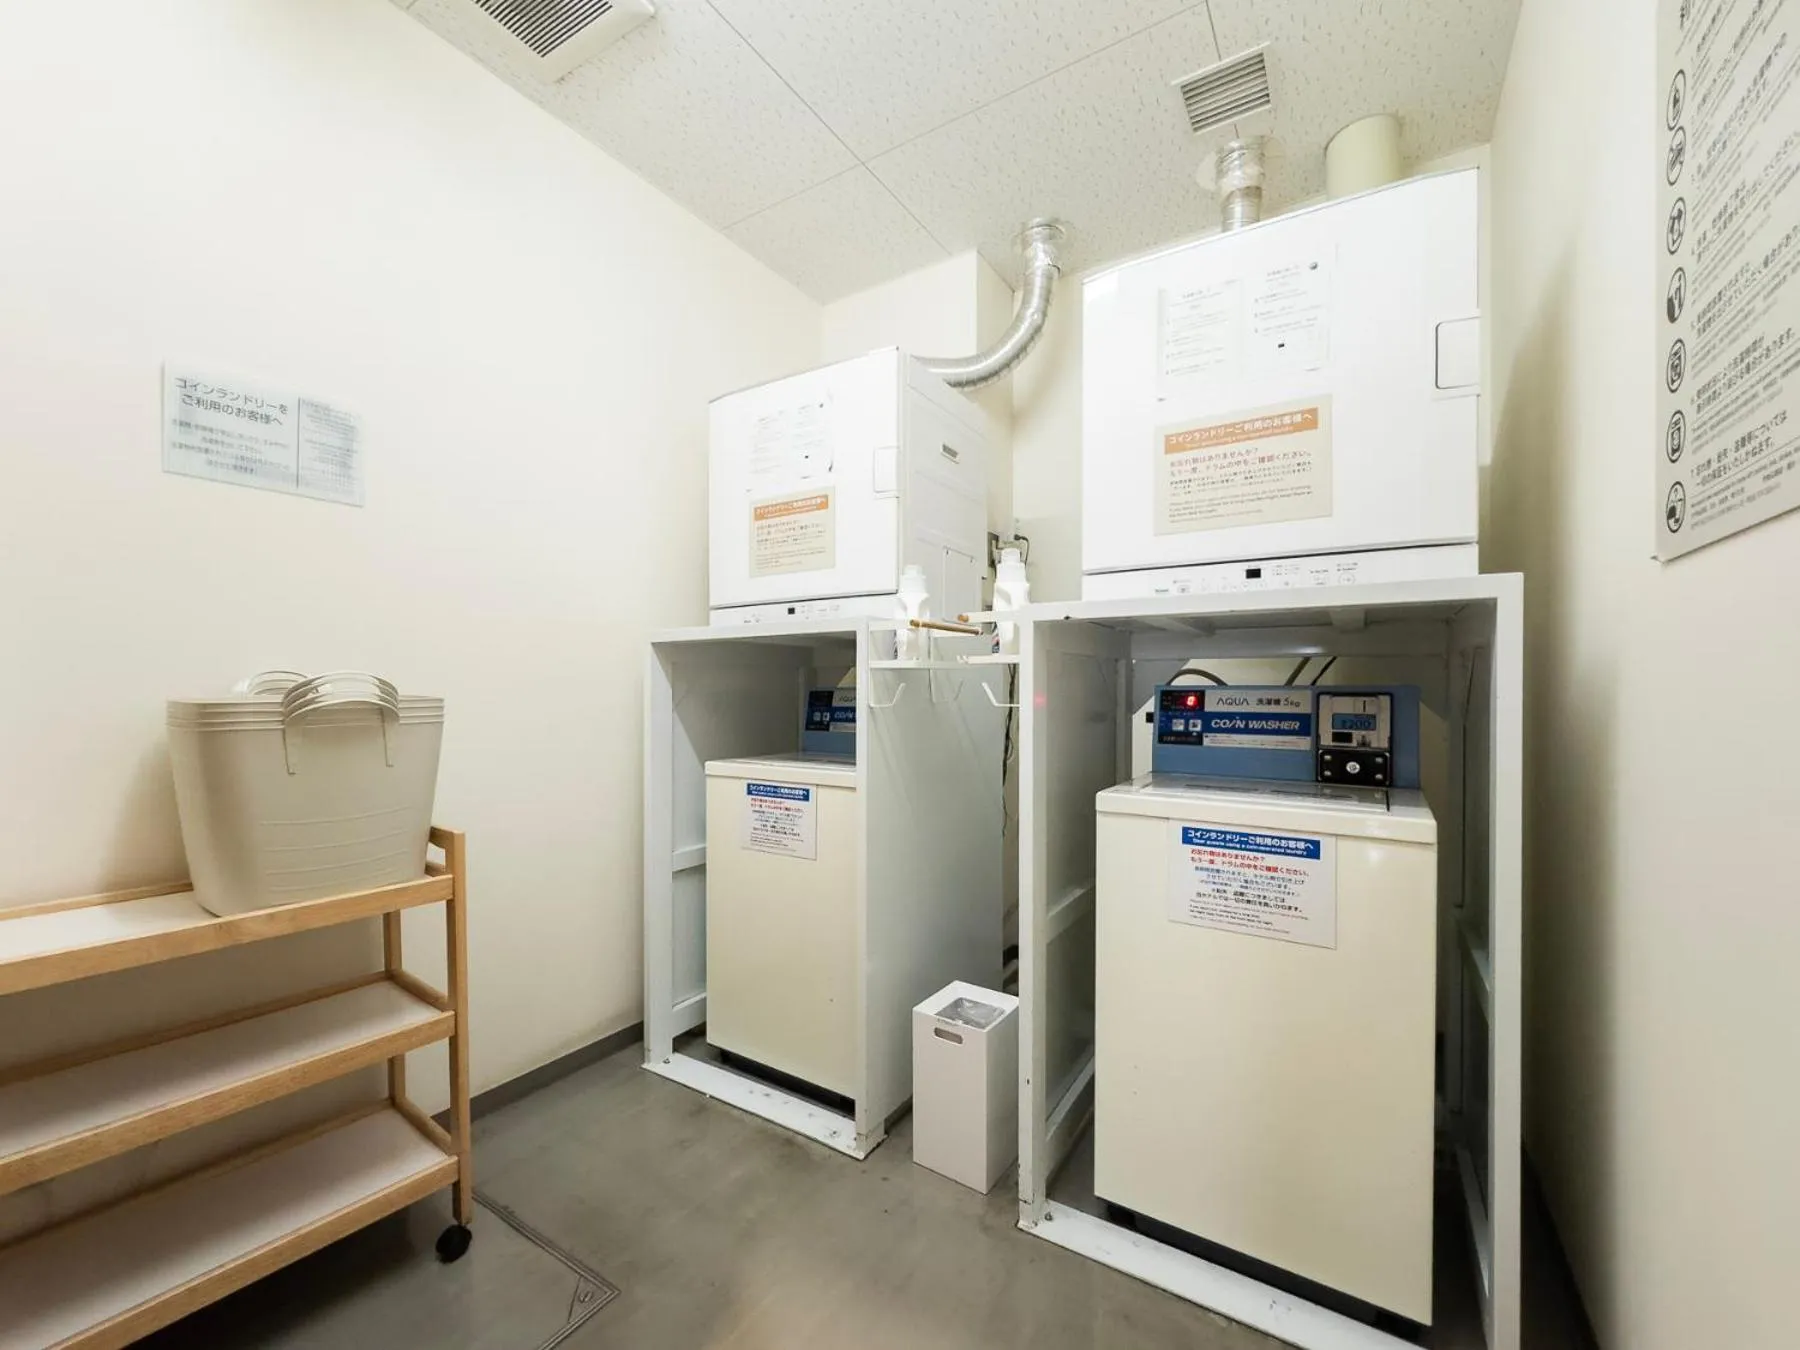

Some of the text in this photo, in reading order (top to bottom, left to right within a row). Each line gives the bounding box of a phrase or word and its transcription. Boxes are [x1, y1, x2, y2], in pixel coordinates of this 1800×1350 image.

[175, 377, 288, 412] コインランドリーを
[181, 394, 284, 426] ご利用のお客様へ
[1168, 413, 1313, 446] コインランドリーご利用のお客様へ
[1216, 697, 1250, 706] AQUA
[1256, 697, 1281, 706] 洗濯機
[1211, 716, 1300, 730] COIN WASHER
[1187, 829, 1314, 850] コインランドリーご利用のお客様へ
